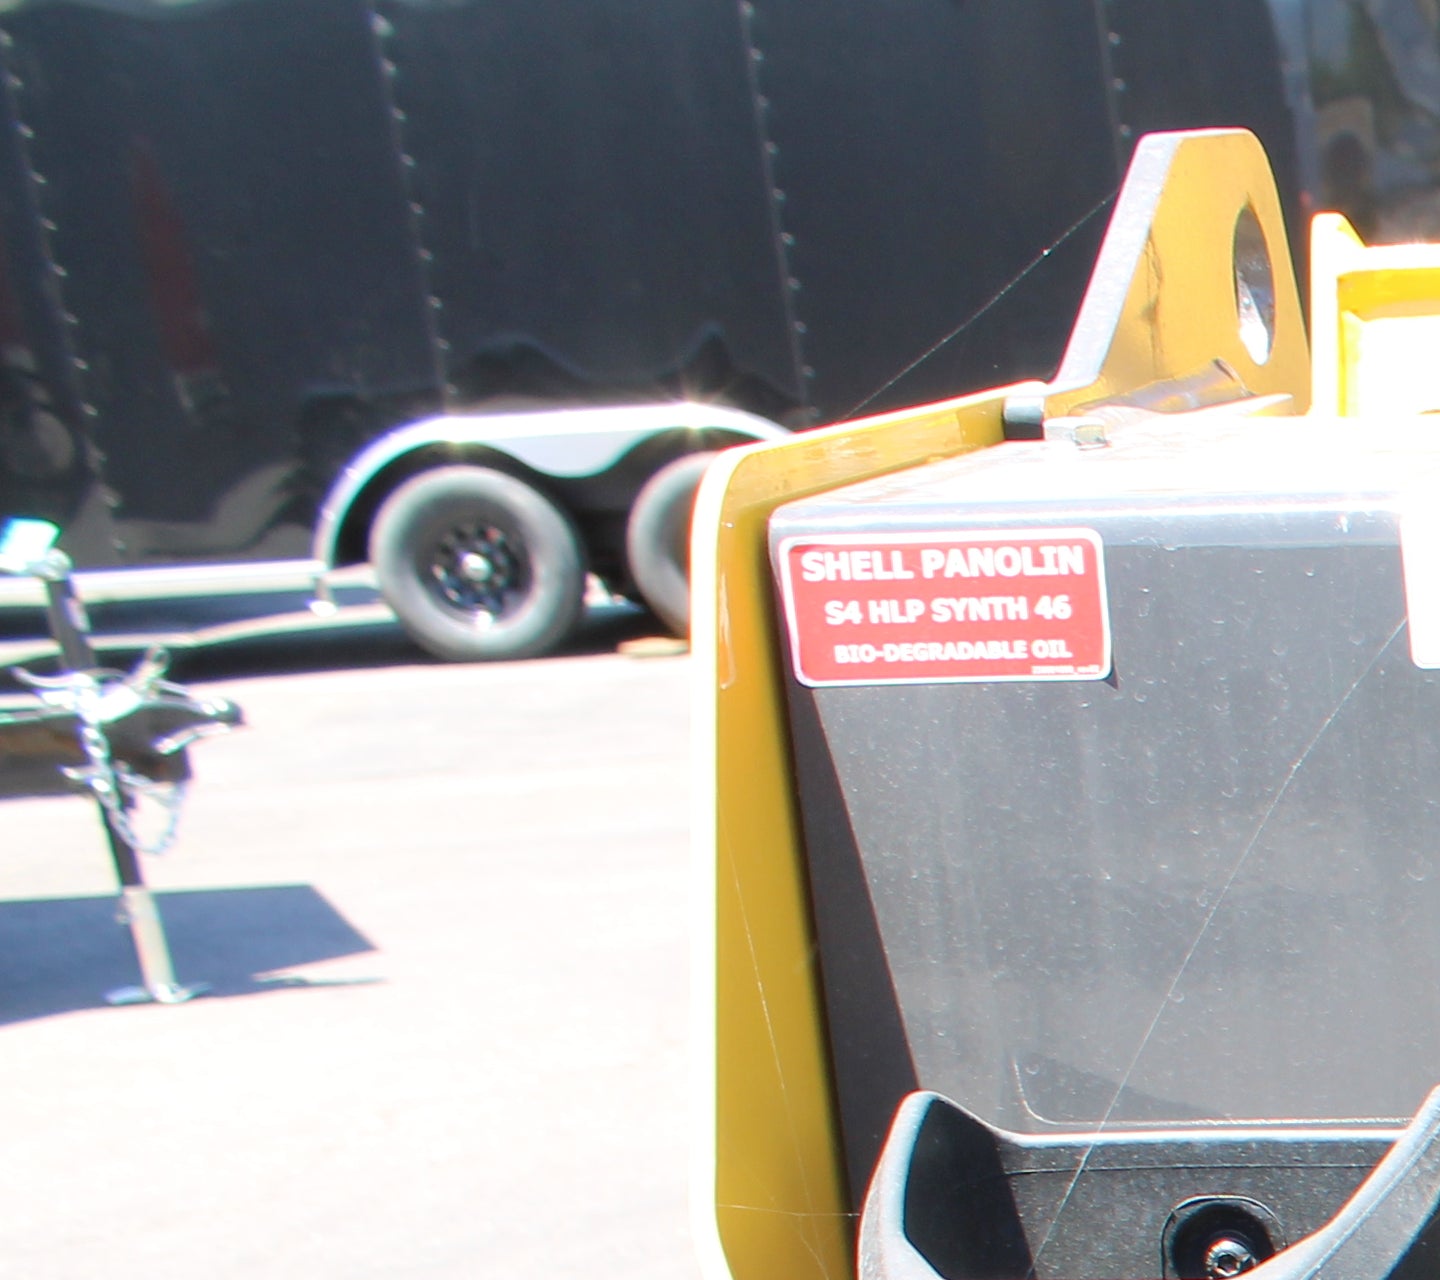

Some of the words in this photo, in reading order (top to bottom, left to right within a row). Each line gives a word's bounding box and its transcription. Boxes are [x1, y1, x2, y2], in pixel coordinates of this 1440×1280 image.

[801, 550, 914, 582] SHELL
[921, 545, 1085, 579] PANOLIN
[824, 600, 862, 626] S4
[869, 598, 926, 624] HLP
[931, 596, 1029, 623] SYNTH
[1034, 594, 1072, 620] 46
[834, 640, 1028, 664] BIO-DEGRADABLE
[1031, 639, 1073, 659] OIL
